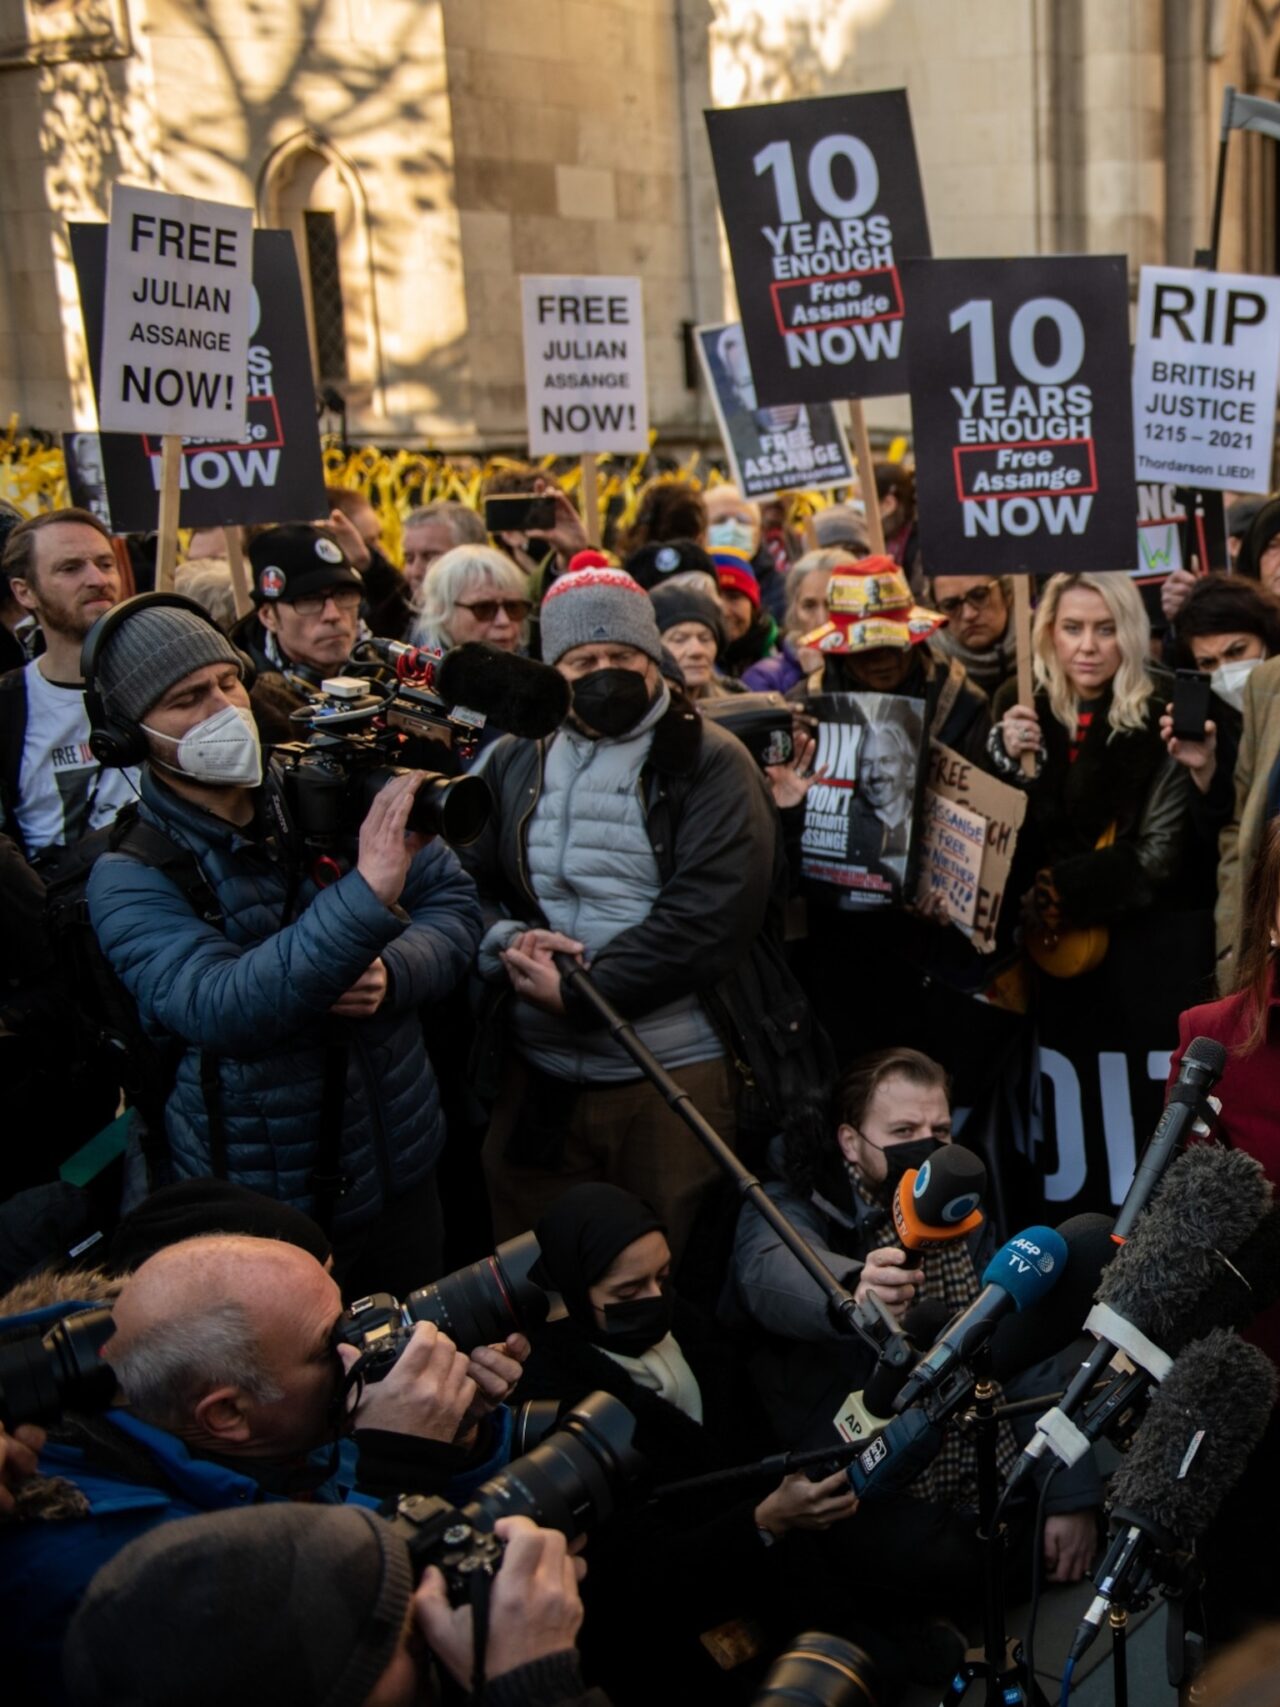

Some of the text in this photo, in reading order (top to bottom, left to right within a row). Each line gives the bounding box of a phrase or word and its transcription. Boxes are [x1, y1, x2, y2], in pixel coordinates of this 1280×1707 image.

[752, 133, 880, 224] 10
[129, 213, 238, 268] FREE
[761, 214, 893, 256] YEARS
[772, 245, 894, 280] ENOUGH
[133, 276, 231, 314] JULIAN
[810, 279, 862, 303] Free
[538, 295, 630, 325] FREE
[792, 294, 890, 326] Assange
[1151, 282, 1267, 346] RIP
[130, 322, 231, 352] ASSANGE
[543, 340, 627, 361] JULIAN
[785, 320, 903, 369] NOW
[949, 296, 1085, 386] 10
[121, 364, 234, 411] NOW!
[544, 372, 630, 389] ASSANGE
[1152, 361, 1256, 391] BRITISH
[951, 384, 1093, 419] YEARS
[1145, 393, 1256, 424] JUSTICE
[541, 404, 636, 434] NOW!
[959, 415, 1092, 443] ENOUGH
[760, 429, 815, 454] FREE
[1144, 423, 1187, 443] 1215
[1209, 430, 1253, 450] 2021
[744, 443, 842, 479] ASSANGE
[996, 448, 1053, 469] Free
[1138, 455, 1255, 480] Thordarson LIED!
[973, 466, 1082, 493] Assange
[963, 495, 1094, 538] NOW
[51, 745, 78, 767] FREE
[929, 749, 971, 791] FREE
[931, 797, 984, 842] ASSANGE
[1011, 1238, 1041, 1255] AFP
[1008, 1254, 1031, 1273] TV
[845, 1413, 862, 1434] AP
